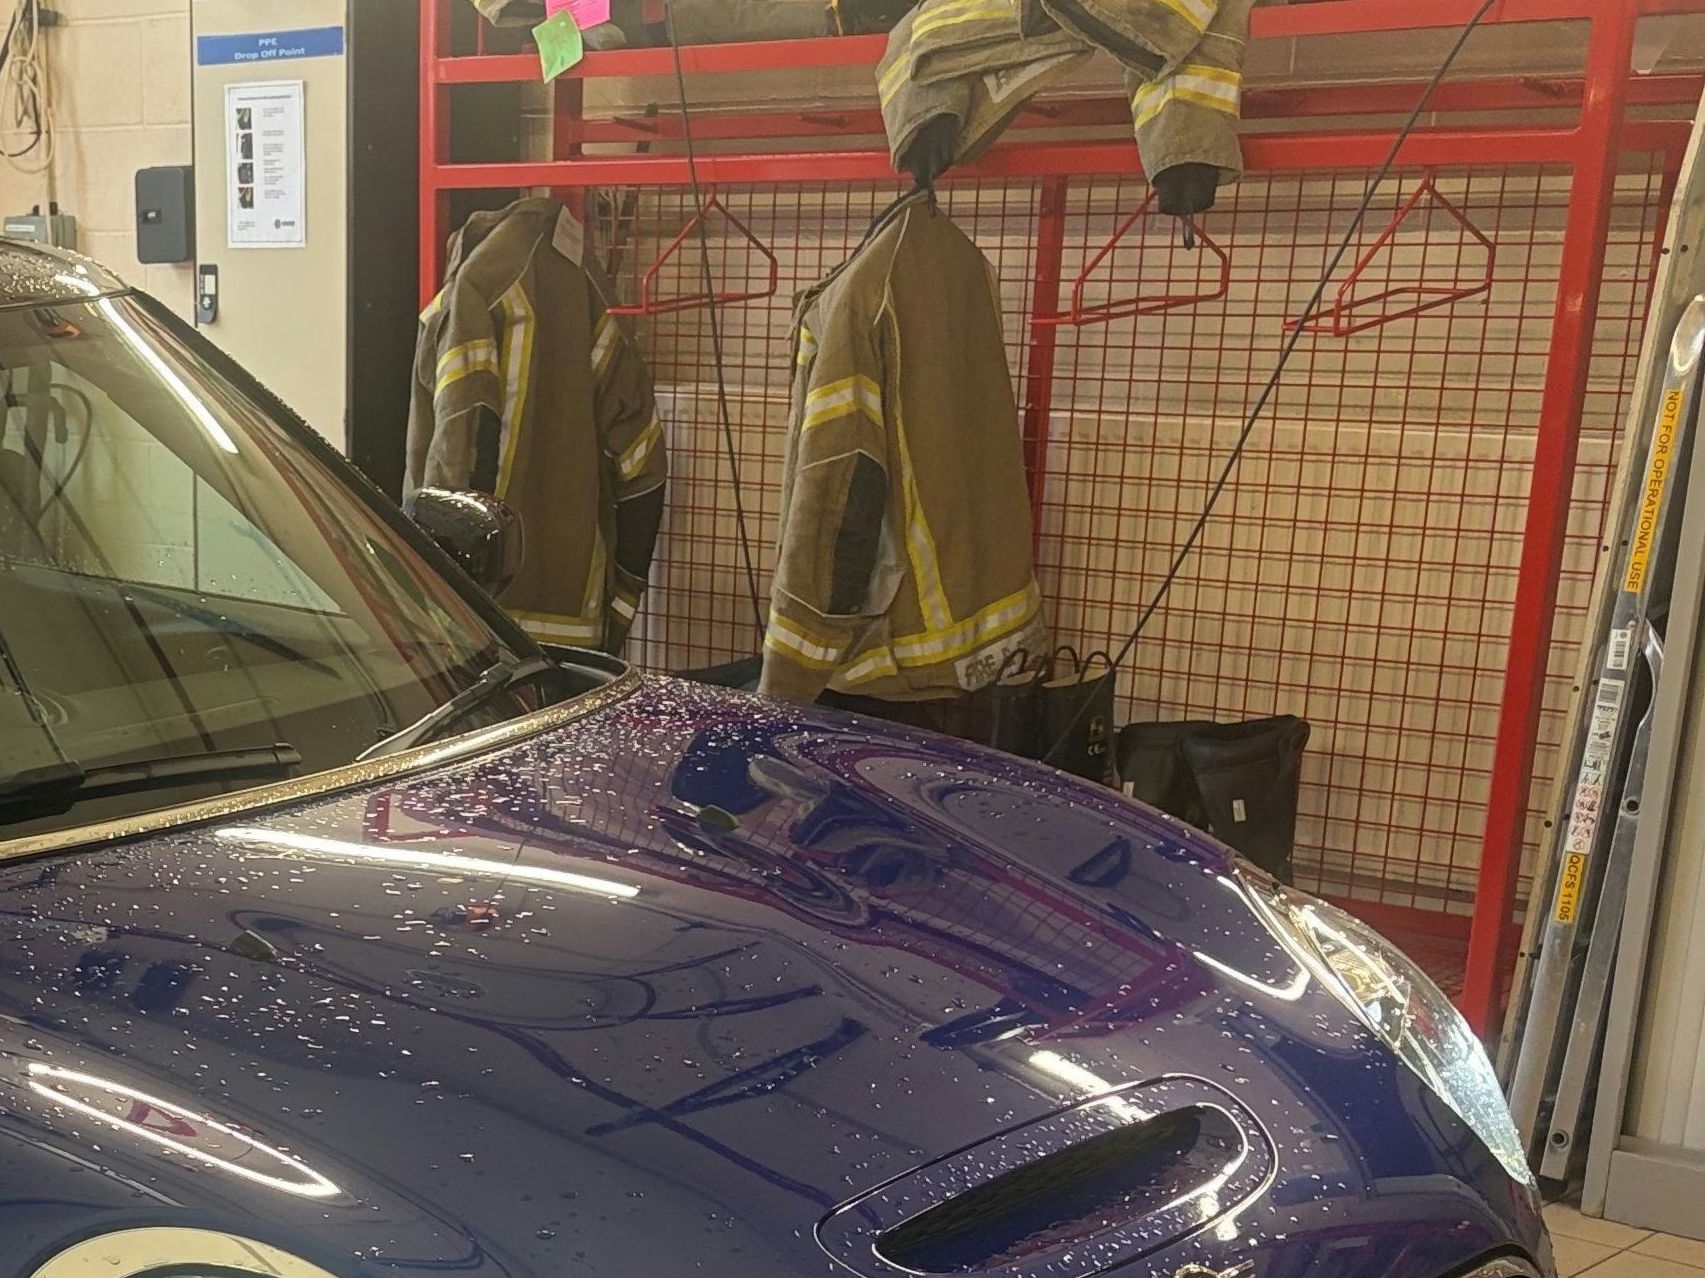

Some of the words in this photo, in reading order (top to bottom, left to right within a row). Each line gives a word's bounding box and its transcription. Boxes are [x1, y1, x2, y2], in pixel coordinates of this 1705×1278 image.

[234, 52, 259, 60] Drop
[260, 49, 277, 58] Off
[278, 47, 306, 56] Point
[258, 38, 277, 46] PPE
[1663, 391, 1680, 421] NOT
[1656, 424, 1673, 455] FOR
[1634, 459, 1665, 557] OPERATIONAL
[1627, 561, 1643, 591] USE
[1564, 854, 1581, 889] QCFS
[1558, 892, 1573, 921] 1105
